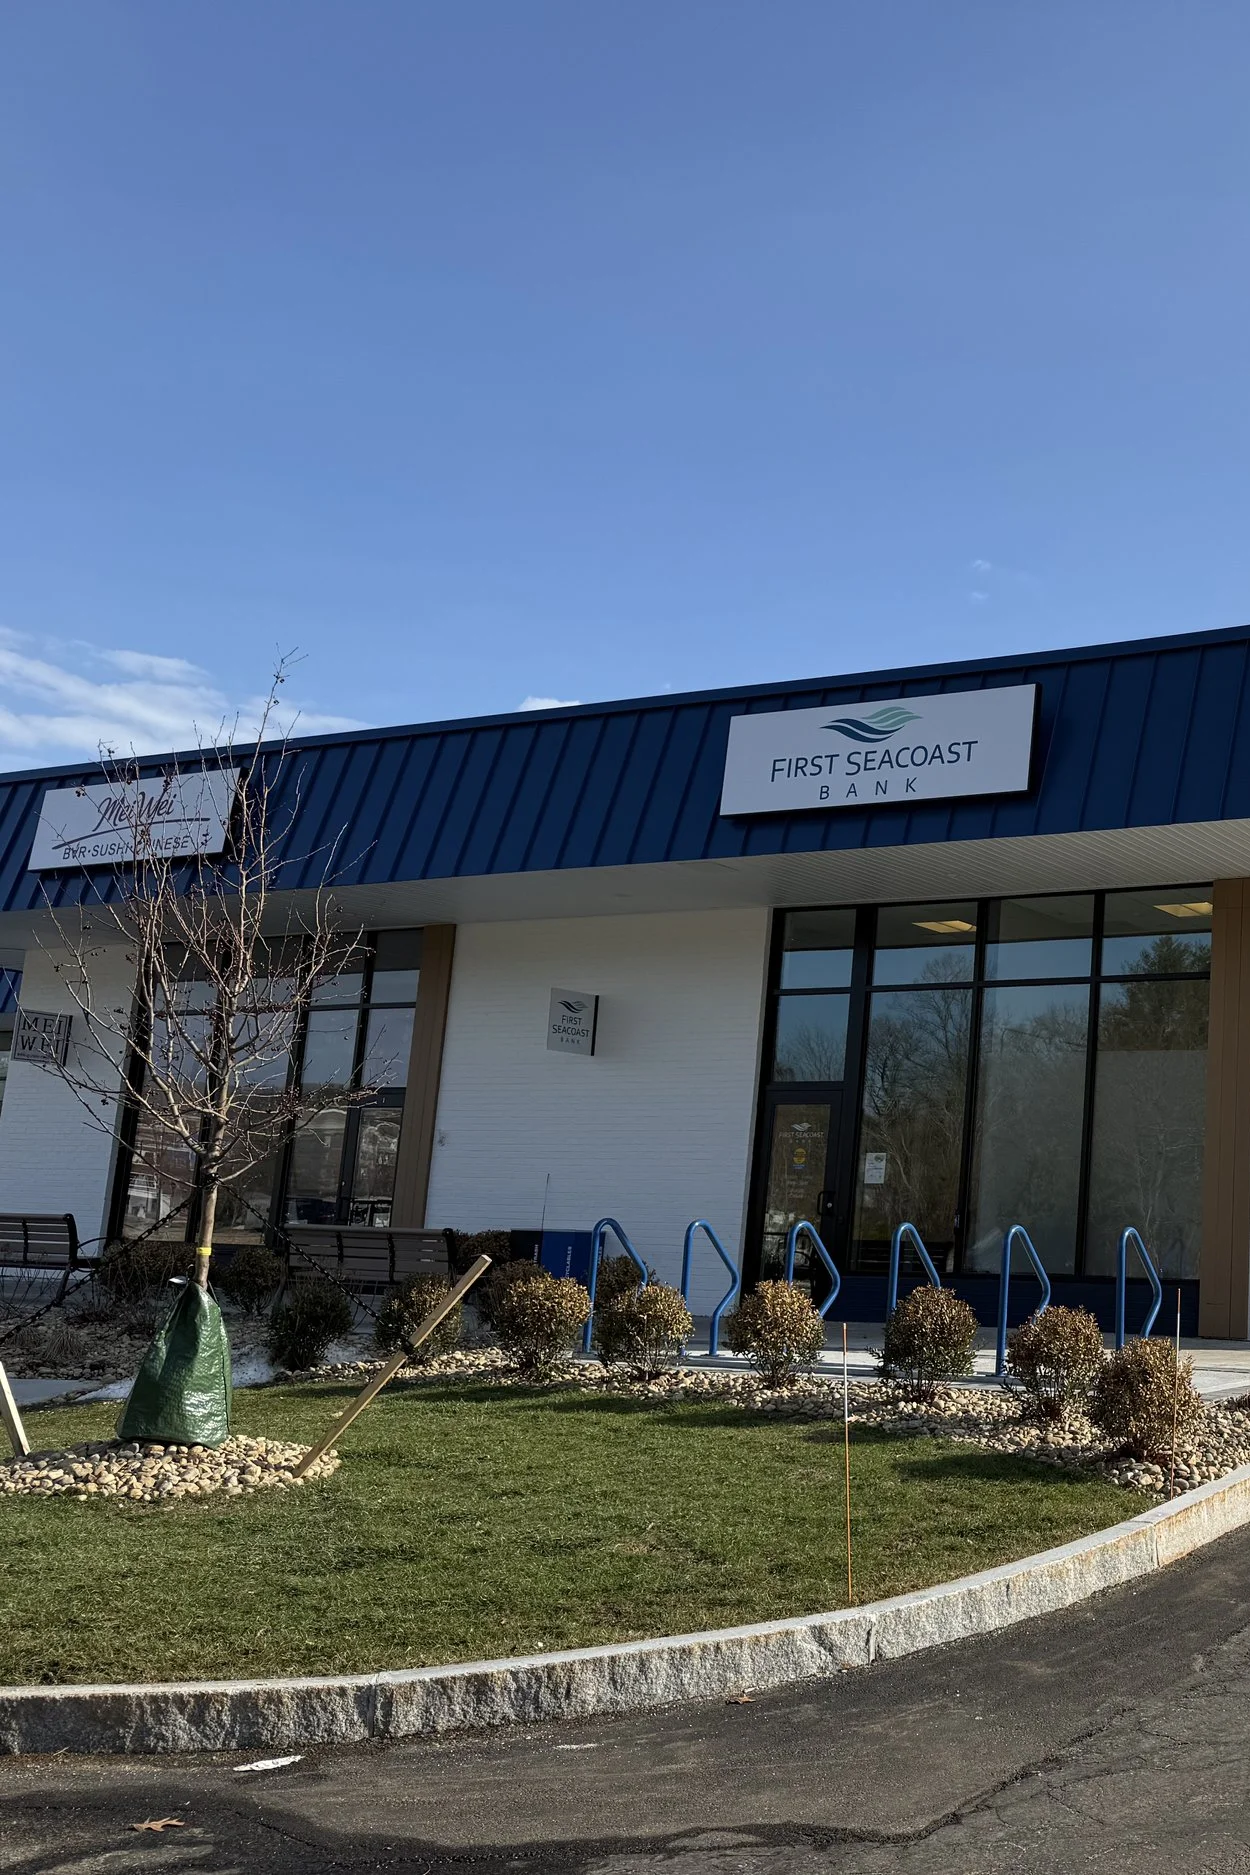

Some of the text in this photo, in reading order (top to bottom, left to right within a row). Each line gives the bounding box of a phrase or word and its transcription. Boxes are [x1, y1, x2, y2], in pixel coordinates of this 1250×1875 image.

[770, 740, 978, 782] FIRST SEACOAST
[819, 777, 917, 800] BANK
[92, 796, 137, 832] Mei
[22, 1016, 64, 1035] MEI
[561, 1014, 582, 1026] FIRST
[552, 1024, 590, 1038] SEACOAST
